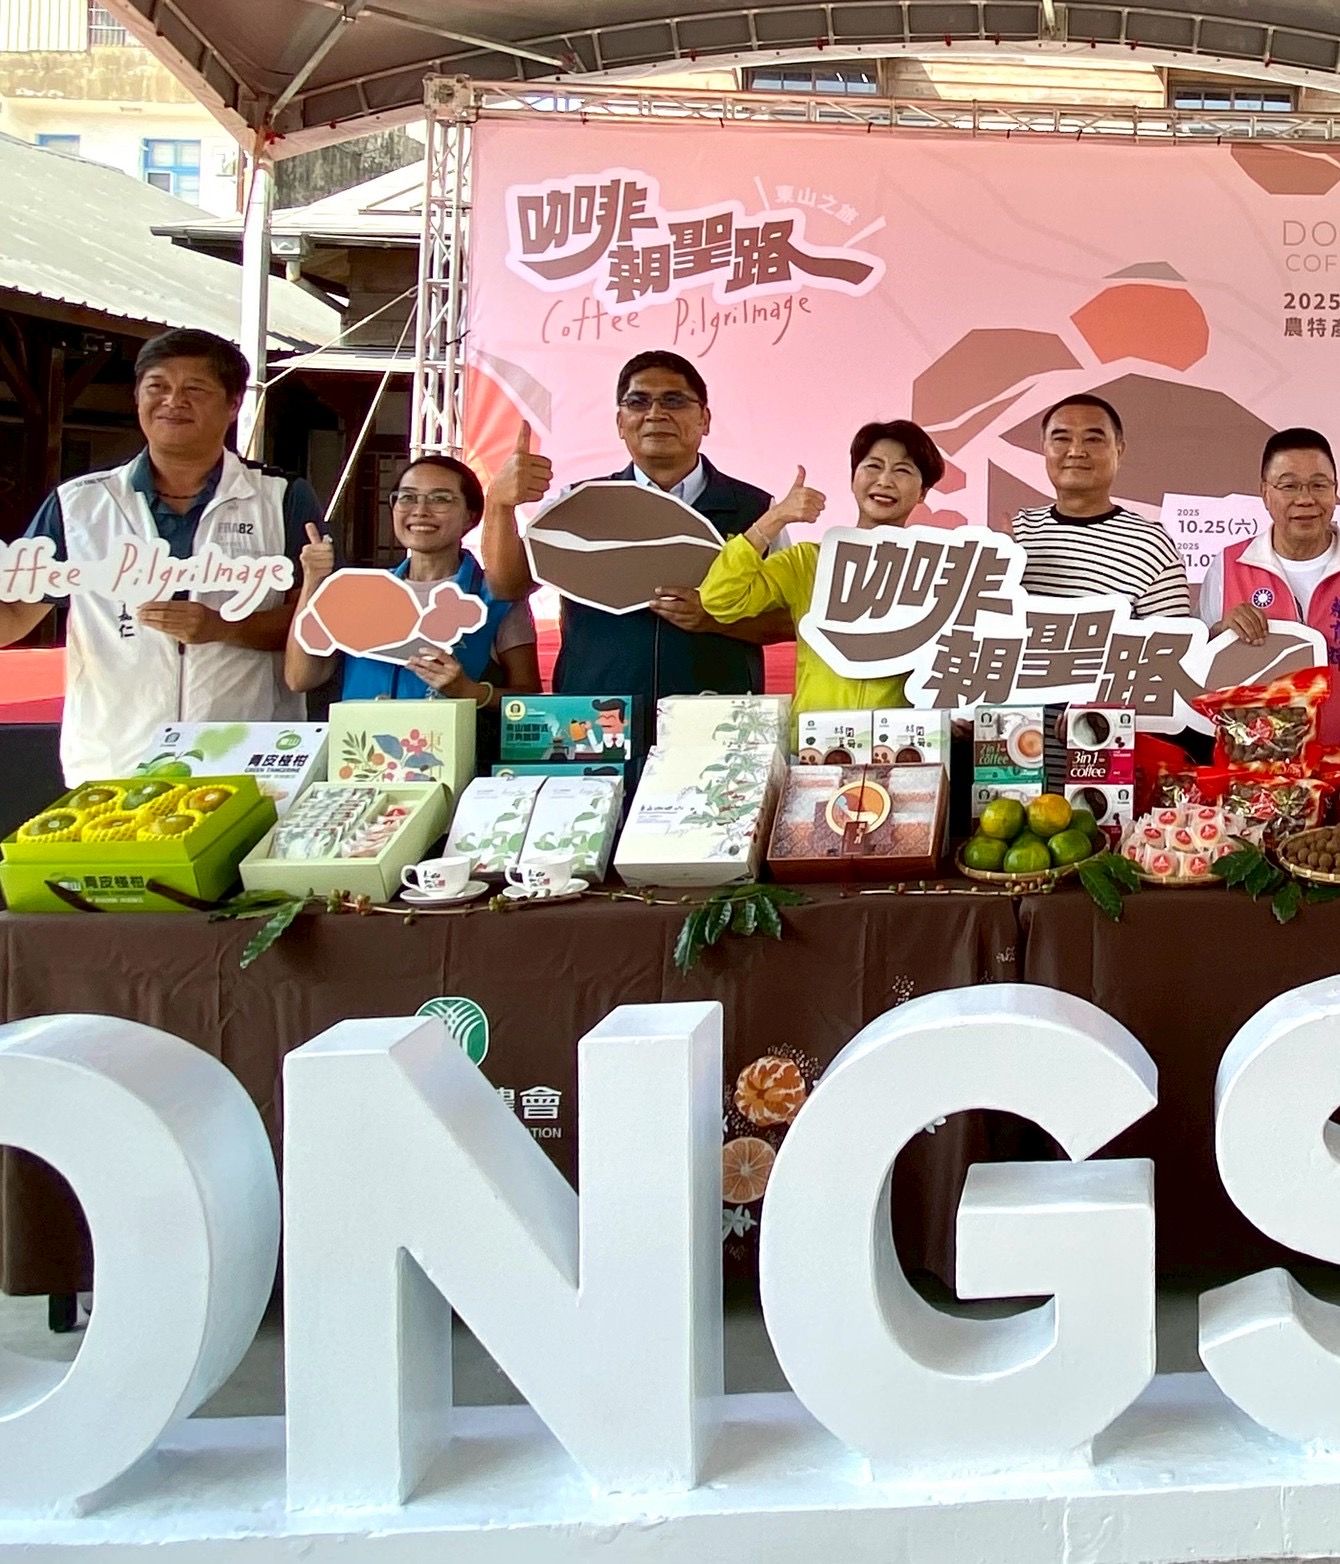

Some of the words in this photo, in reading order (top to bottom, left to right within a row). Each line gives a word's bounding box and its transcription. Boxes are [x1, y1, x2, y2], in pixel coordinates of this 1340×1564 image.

[775, 185, 860, 226] 東山之旅
[517, 178, 659, 281] 咖啡
[542, 299, 640, 344] Coffee
[1177, 508, 1200, 517] 2025
[1177, 542, 1200, 551] 2025
[816, 540, 1014, 662] 咖啡
[922, 608, 1206, 718] 朝聖路
[1070, 763, 1106, 778] coffee
